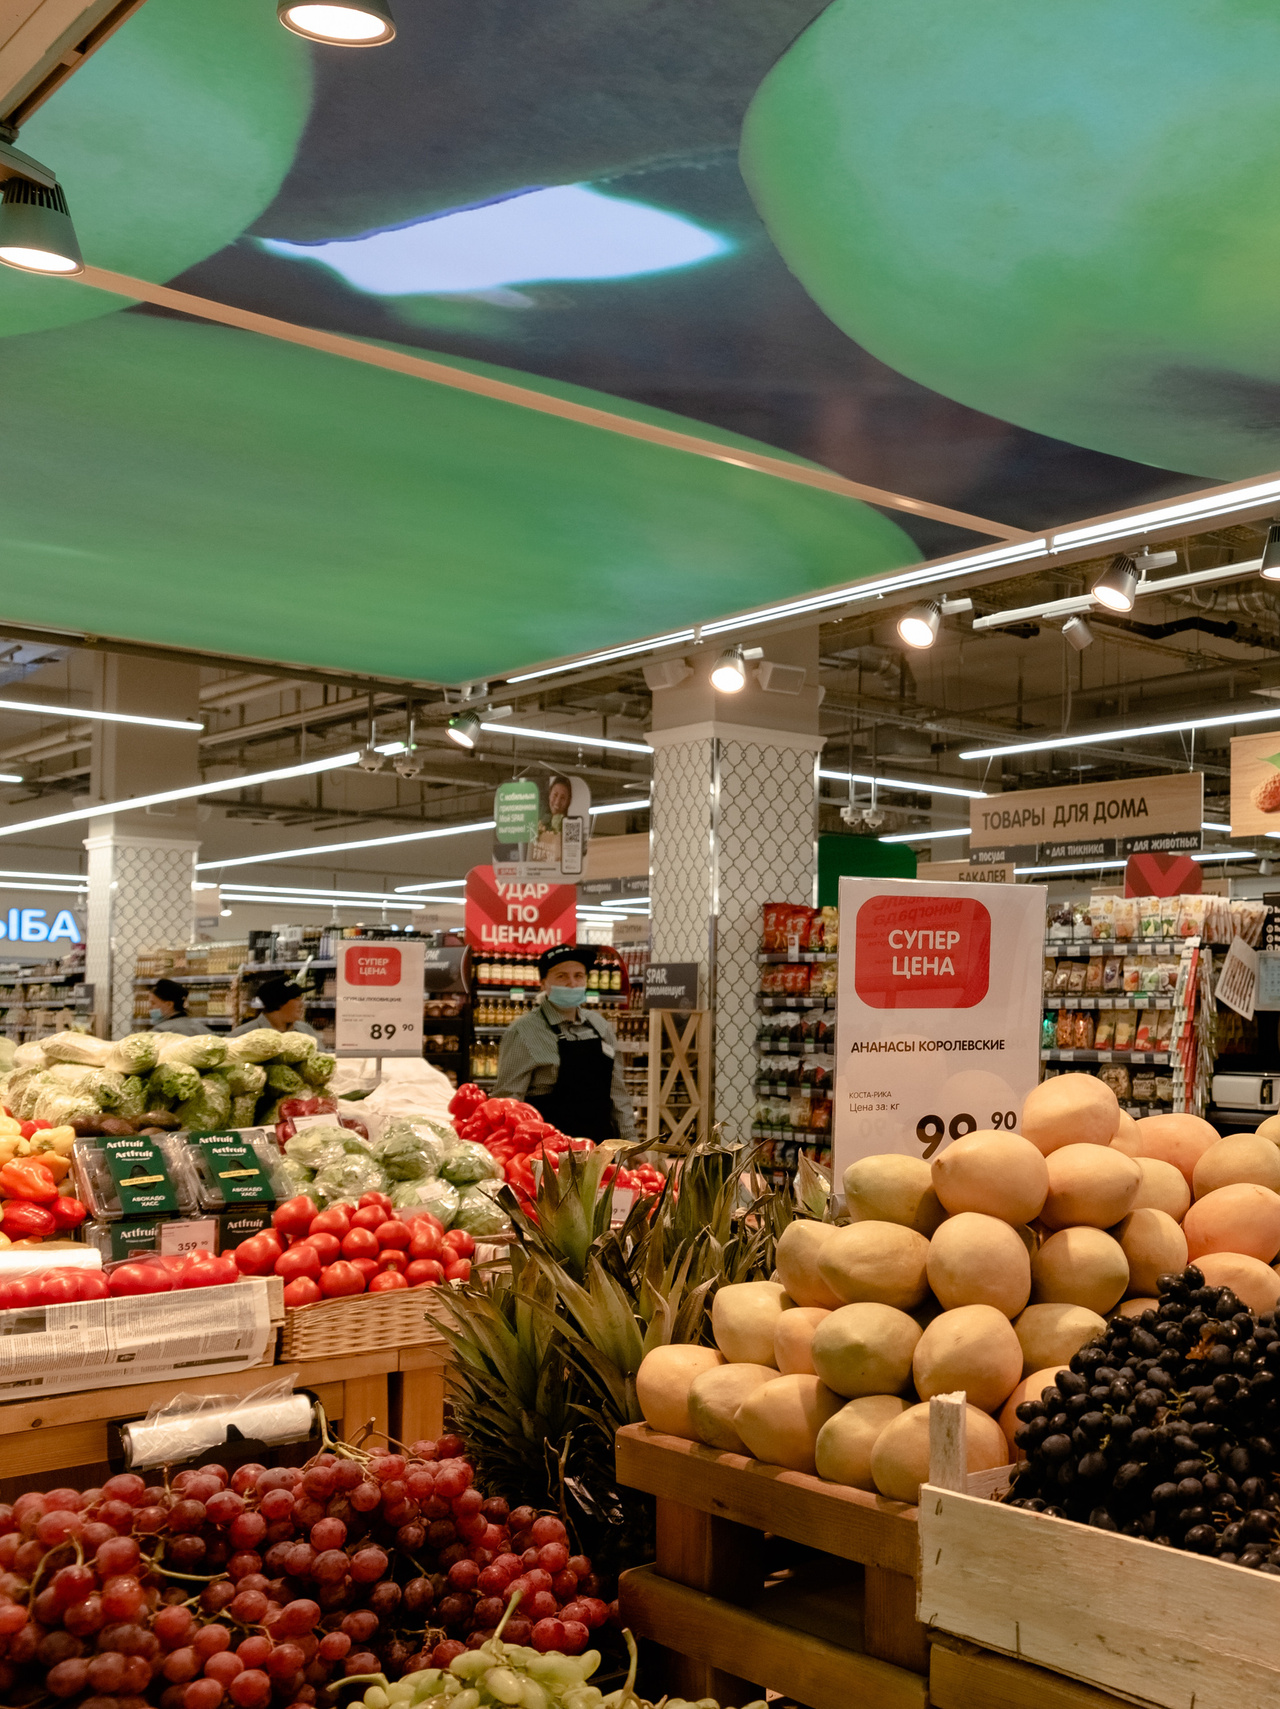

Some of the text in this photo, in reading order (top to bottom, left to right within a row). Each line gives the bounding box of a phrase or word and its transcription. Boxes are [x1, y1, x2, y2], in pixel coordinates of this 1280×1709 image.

[982, 797, 1148, 830] ТОВАРЫ ДЛЯ ДОМА
[1051, 843, 1104, 858] для пикника
[1133, 836, 1198, 852] для животных
[978, 851, 1005, 865] посуда
[958, 869, 1006, 883] БАКАЛЕЯ
[495, 879, 549, 901] УДАР
[507, 904, 539, 923] ПО
[480, 924, 562, 946] ЦЕНАМ!
[888, 929, 960, 950] СУПЕР
[358, 957, 389, 966] СУПЕР
[892, 956, 955, 979] ЦЕНА
[360, 967, 387, 976] ЦЕНА
[646, 968, 667, 984] SPAR
[646, 985, 685, 998] рекомендует
[370, 1023, 414, 1040] 89 90
[851, 1039, 1005, 1053] АНАНАСЫ КОРОЛЕВСКИЕ
[849, 1091, 892, 1099] КОСТА-РИКА
[849, 1102, 900, 1113] Цена за: кг
[991, 1111, 1017, 1130] 90
[107, 1140, 144, 1149] Artfruit
[199, 1135, 234, 1144] Artfruit
[116, 1150, 153, 1159] Artfruit
[212, 1146, 247, 1154] Artfruit
[132, 1195, 165, 1203] АВОКАДО
[227, 1219, 263, 1230] Artfruit
[178, 1241, 197, 1251] 359
